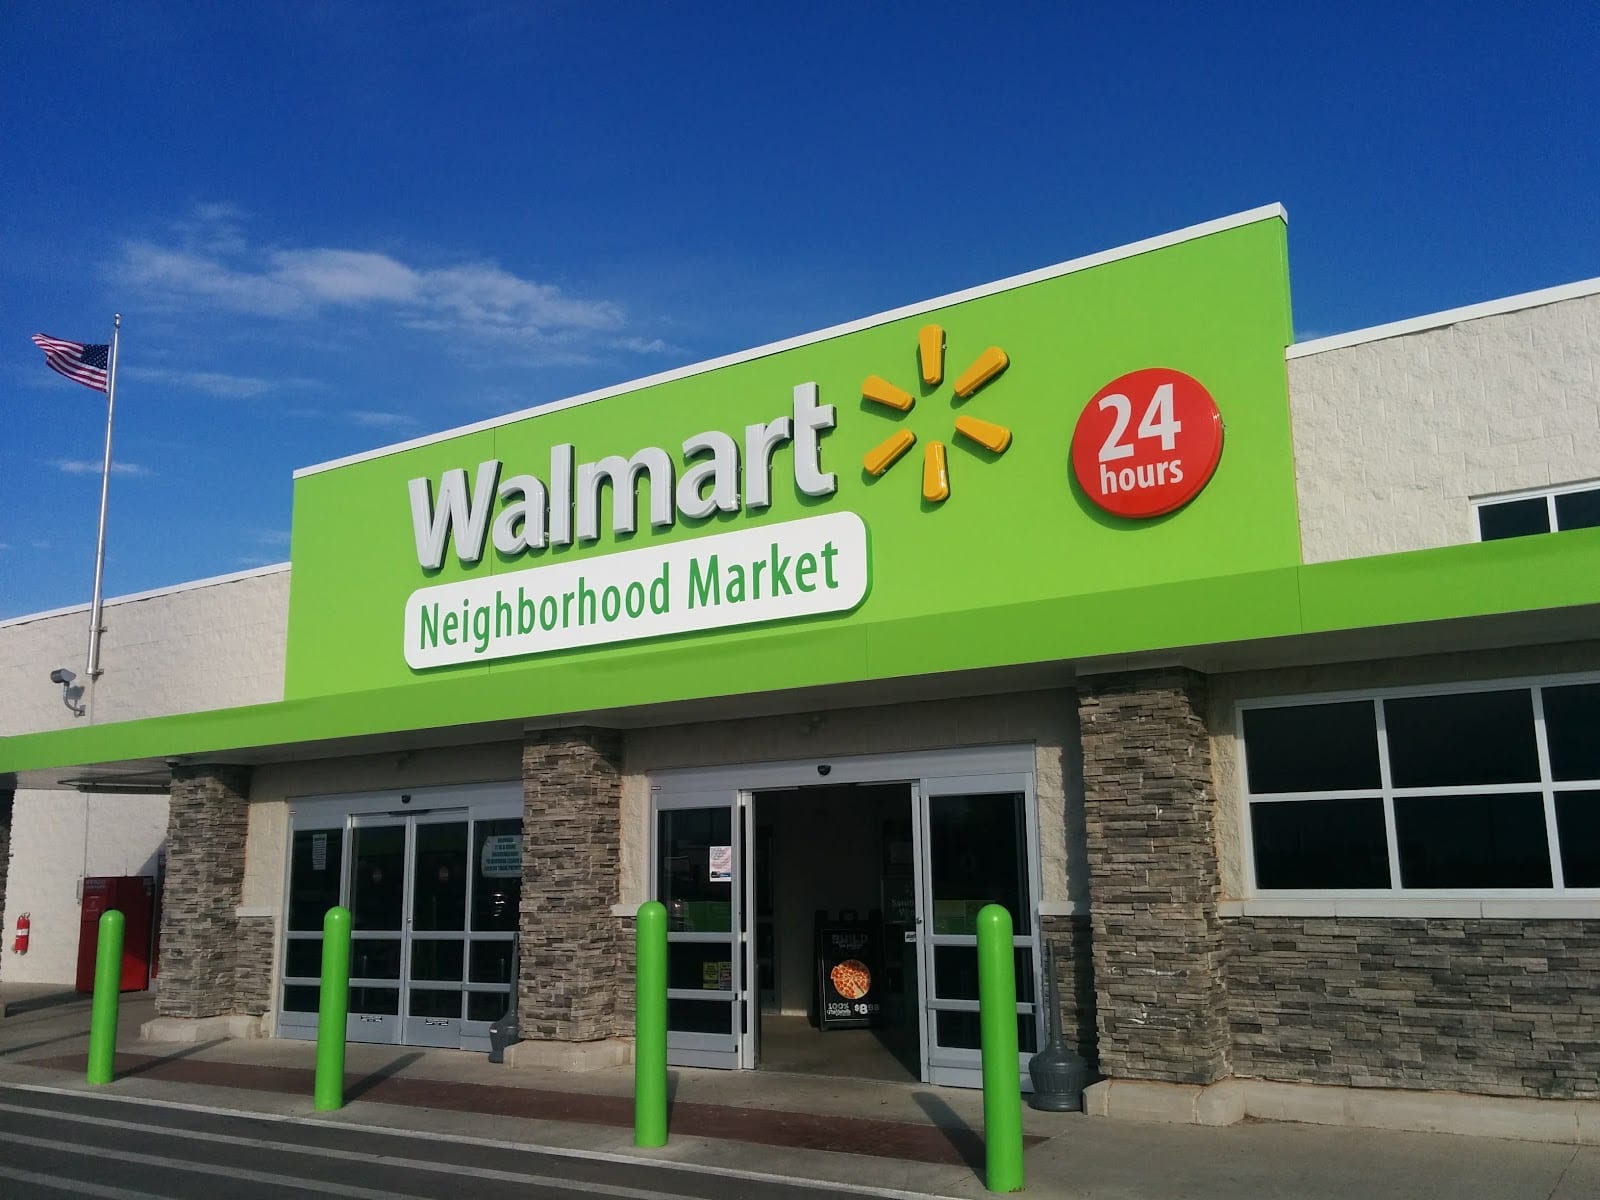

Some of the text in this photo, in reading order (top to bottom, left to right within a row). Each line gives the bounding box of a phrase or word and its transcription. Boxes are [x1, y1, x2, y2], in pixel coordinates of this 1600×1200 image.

[1098, 383, 1181, 462] 24
[408, 382, 836, 570] Walmart
[1100, 459, 1184, 495] hours
[420, 541, 838, 653] Neighborhood Market
